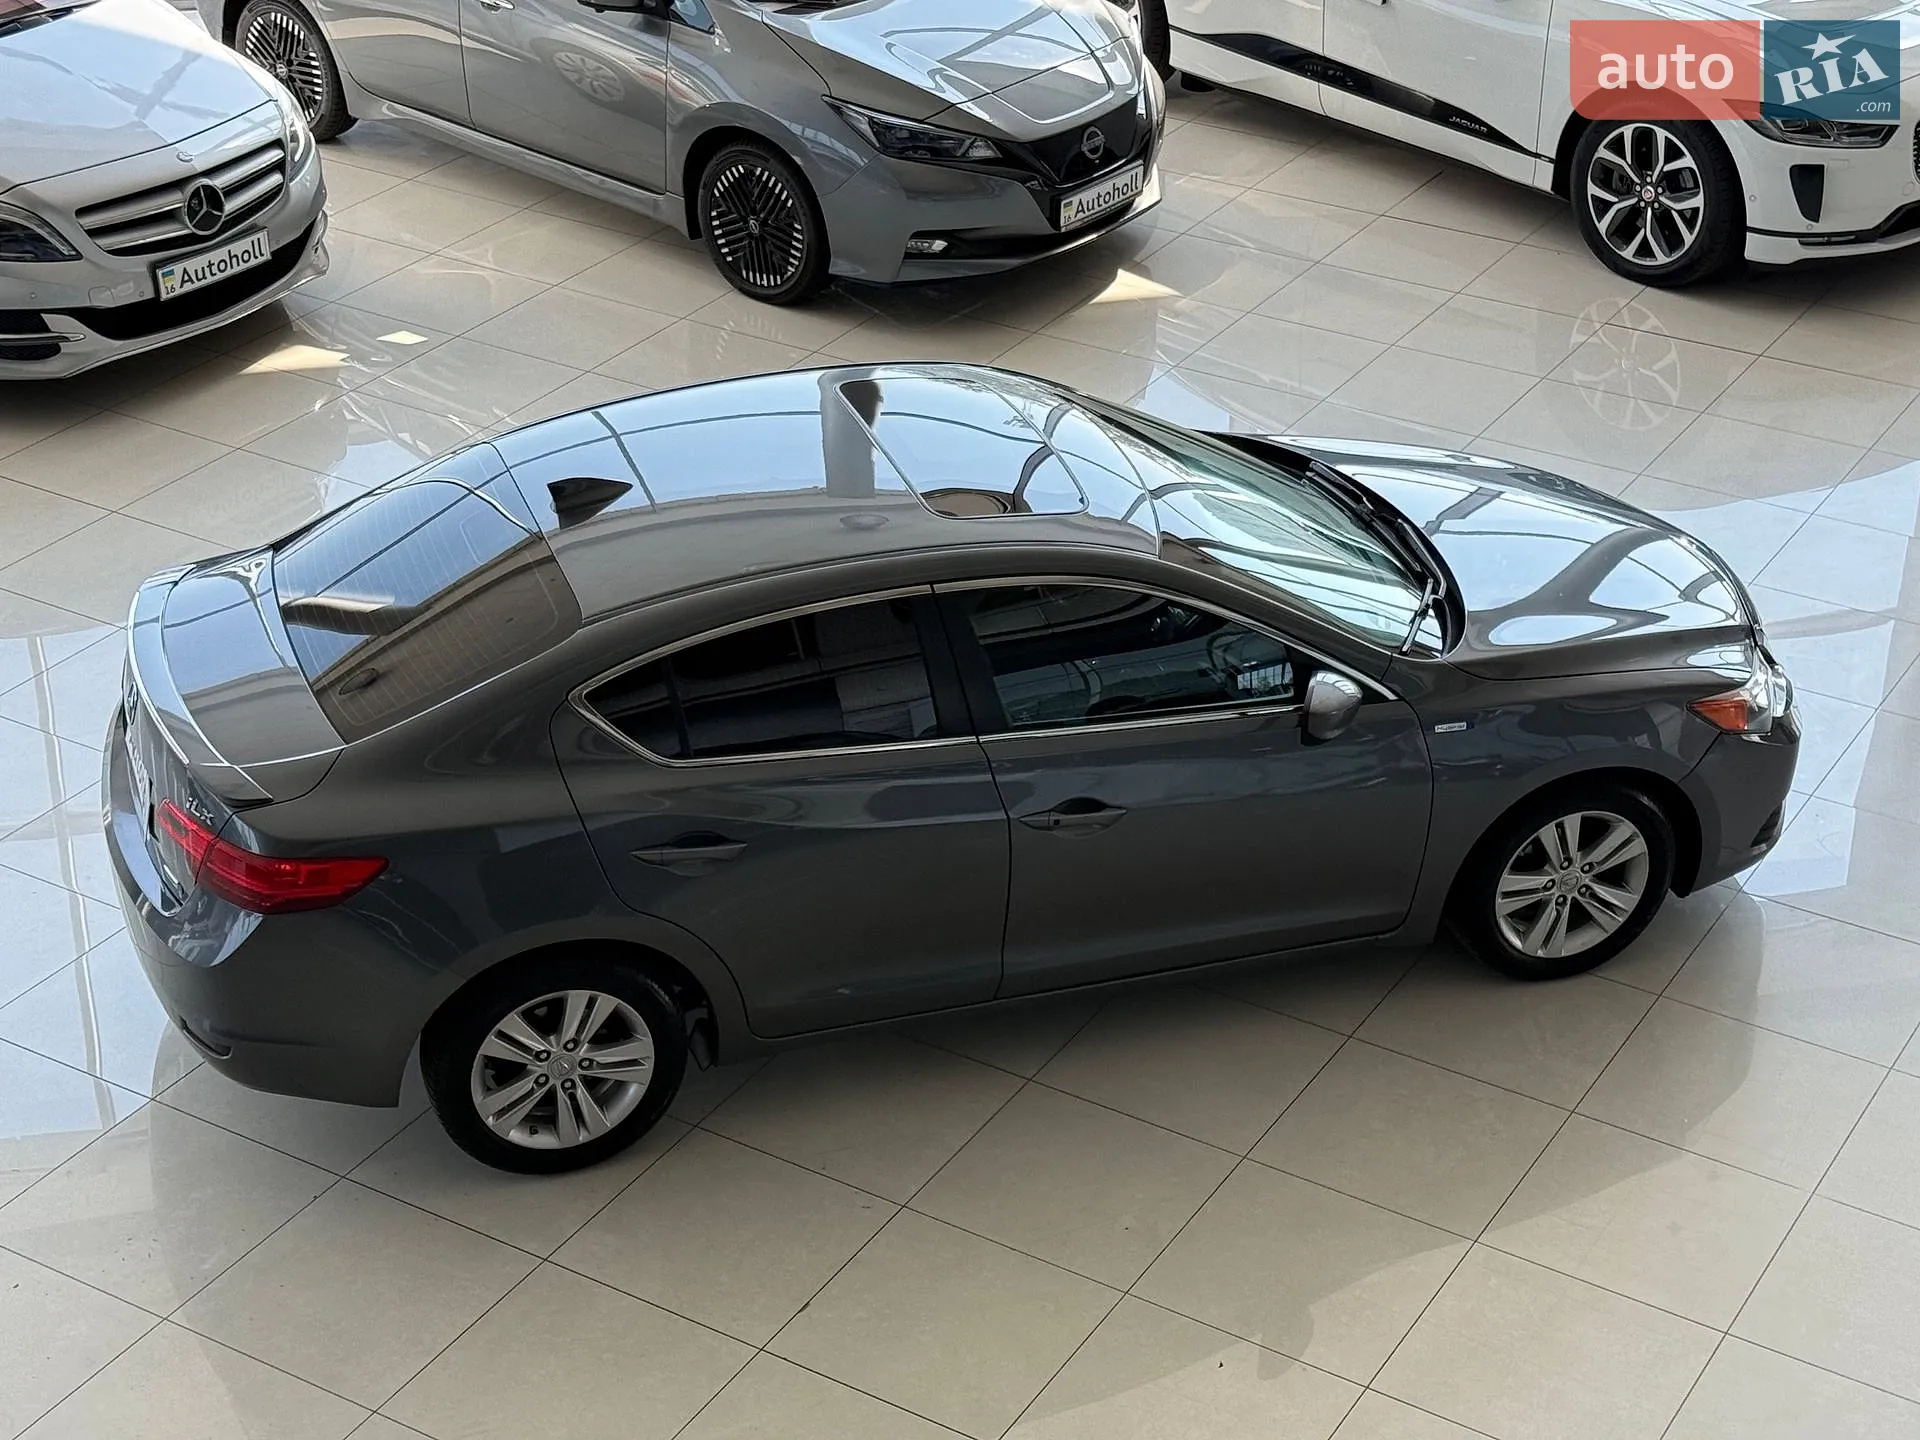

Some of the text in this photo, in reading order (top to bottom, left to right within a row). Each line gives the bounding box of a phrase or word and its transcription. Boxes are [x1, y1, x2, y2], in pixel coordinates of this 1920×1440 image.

[1449, 116, 1488, 133] JAGUAR
[1074, 171, 1139, 218] Autoholl
[179, 237, 265, 289] Autoholl
[165, 284, 177, 296] 16
